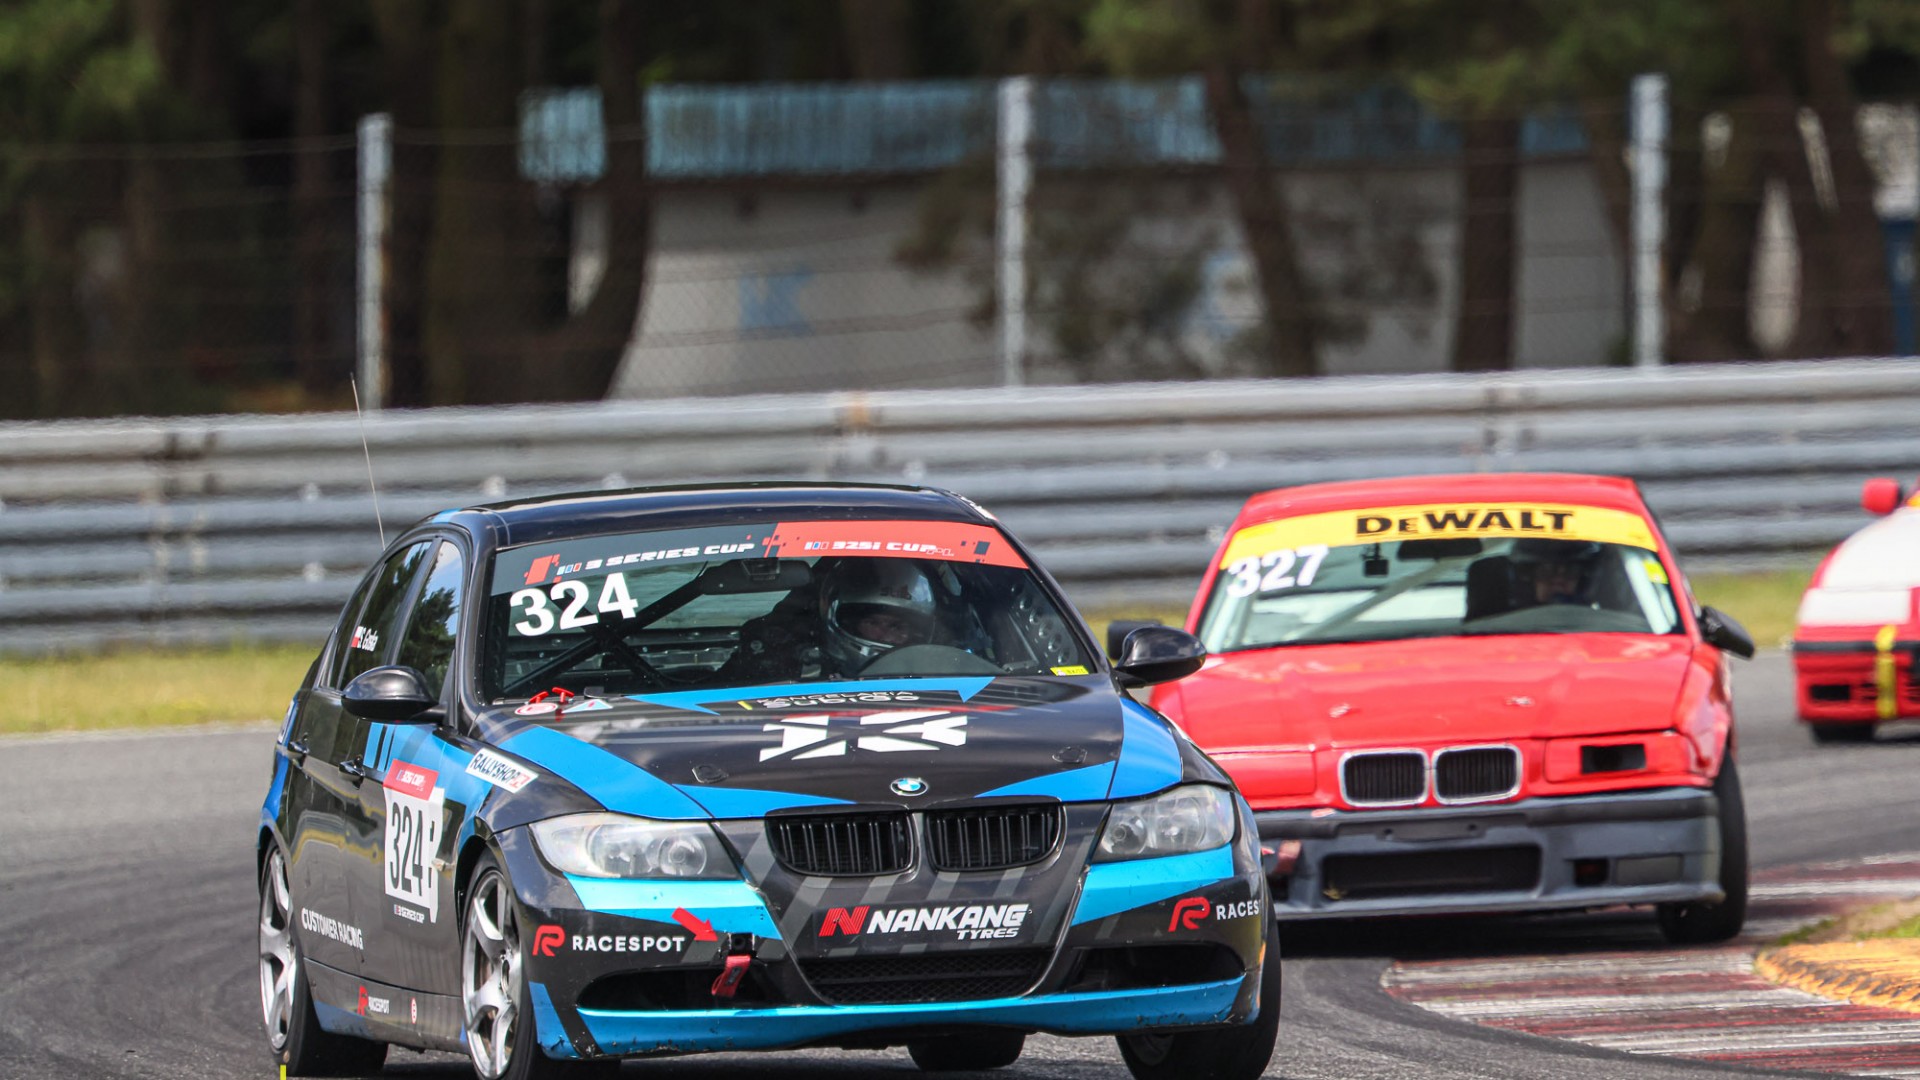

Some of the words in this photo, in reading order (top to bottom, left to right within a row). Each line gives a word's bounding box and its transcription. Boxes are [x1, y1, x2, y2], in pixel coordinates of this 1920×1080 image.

[585, 559, 602, 571] 3
[606, 546, 700, 567] SERIES
[703, 543, 755, 555] CUP
[886, 541, 937, 552] CUP
[1227, 543, 1330, 598] 327
[509, 571, 639, 637] 324
[390, 802, 422, 896] 324
[866, 903, 1030, 934] NANKANG
[1216, 899, 1261, 920] RACES
[302, 907, 339, 941] CUSTOMER
[338, 921, 364, 950] RACING
[957, 927, 1019, 940] TYRES
[572, 935, 685, 952] RACESPOT
